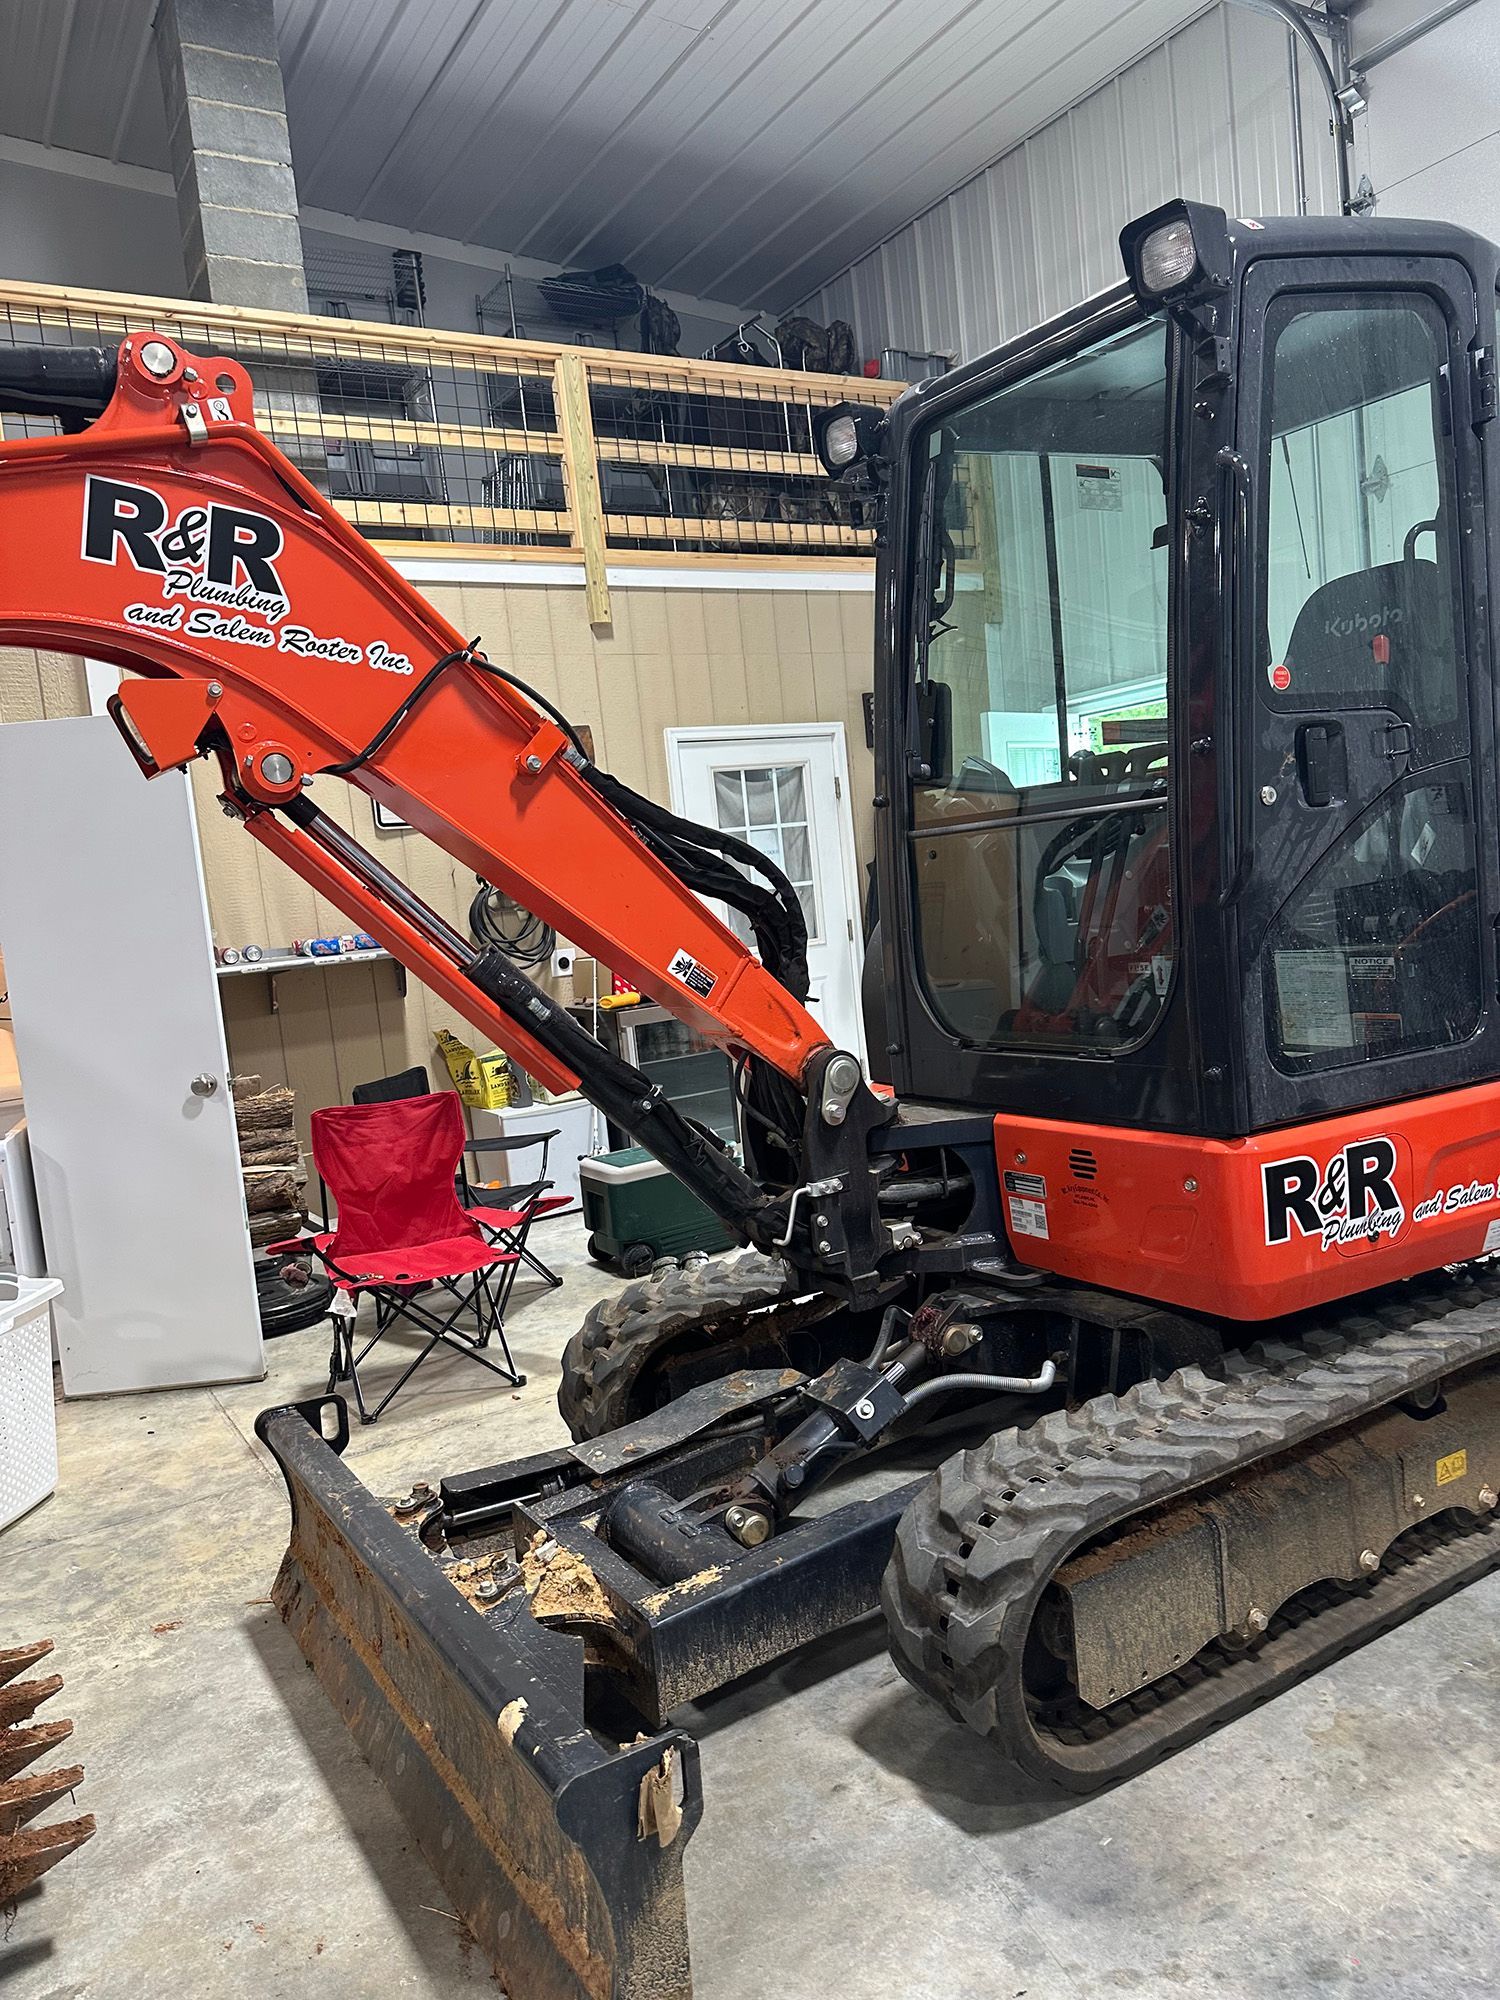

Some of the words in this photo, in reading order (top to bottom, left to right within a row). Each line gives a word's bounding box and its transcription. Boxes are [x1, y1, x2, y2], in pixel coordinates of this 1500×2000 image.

[83, 475, 285, 596] R&R
[166, 572, 288, 621] Plumbing
[127, 604, 180, 628] and
[188, 611, 274, 645] Salem
[282, 628, 363, 662] Rooter
[370, 645, 414, 673] Inc.
[1324, 606, 1408, 637] Kubota
[1264, 1138, 1399, 1242] R&R
[1415, 1193, 1441, 1219] and
[1446, 1183, 1493, 1210] Salem
[1323, 1208, 1402, 1249] Plumbing
